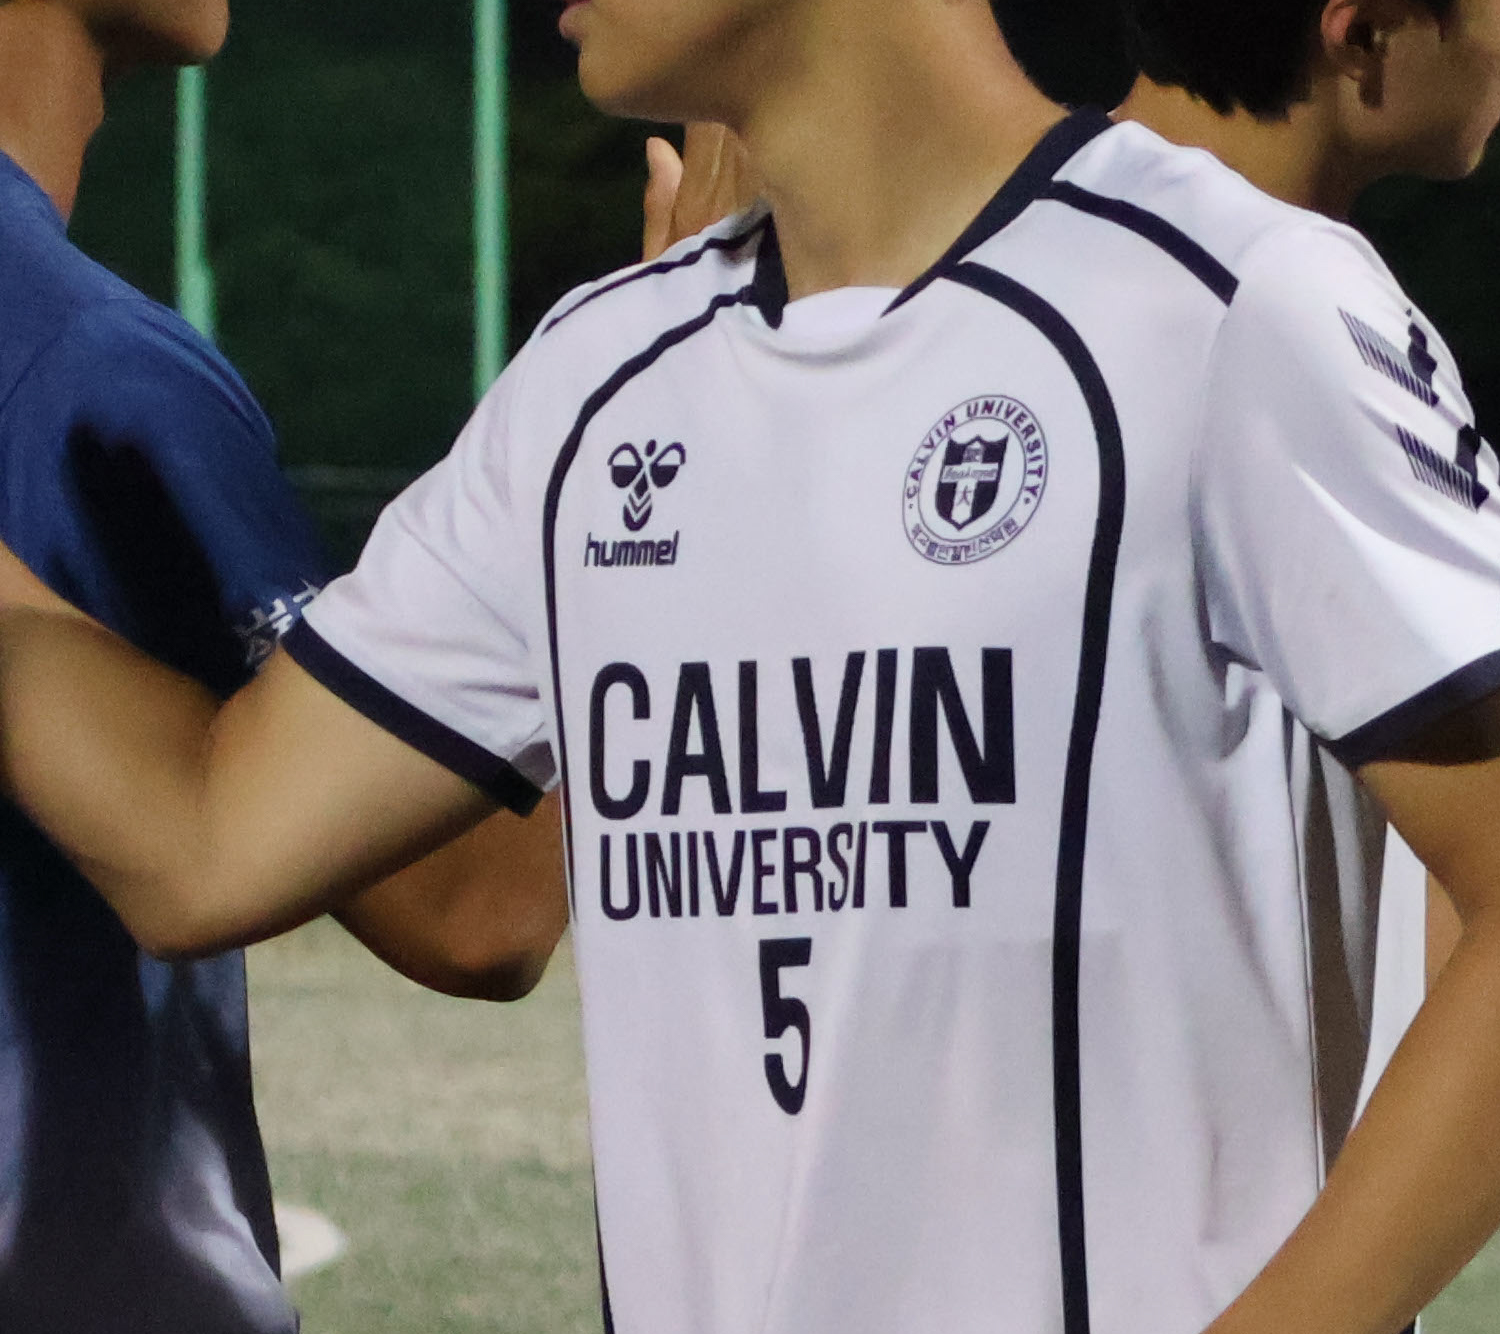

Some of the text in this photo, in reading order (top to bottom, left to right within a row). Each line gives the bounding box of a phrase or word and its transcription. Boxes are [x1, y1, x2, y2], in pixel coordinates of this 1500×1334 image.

[905, 400, 1043, 499] CALVIN UNIVERSITY
[584, 530, 679, 567] hummel
[589, 647, 1017, 821] CALVIN
[600, 820, 991, 921] UNIVERSITY
[758, 937, 812, 1116] 5
